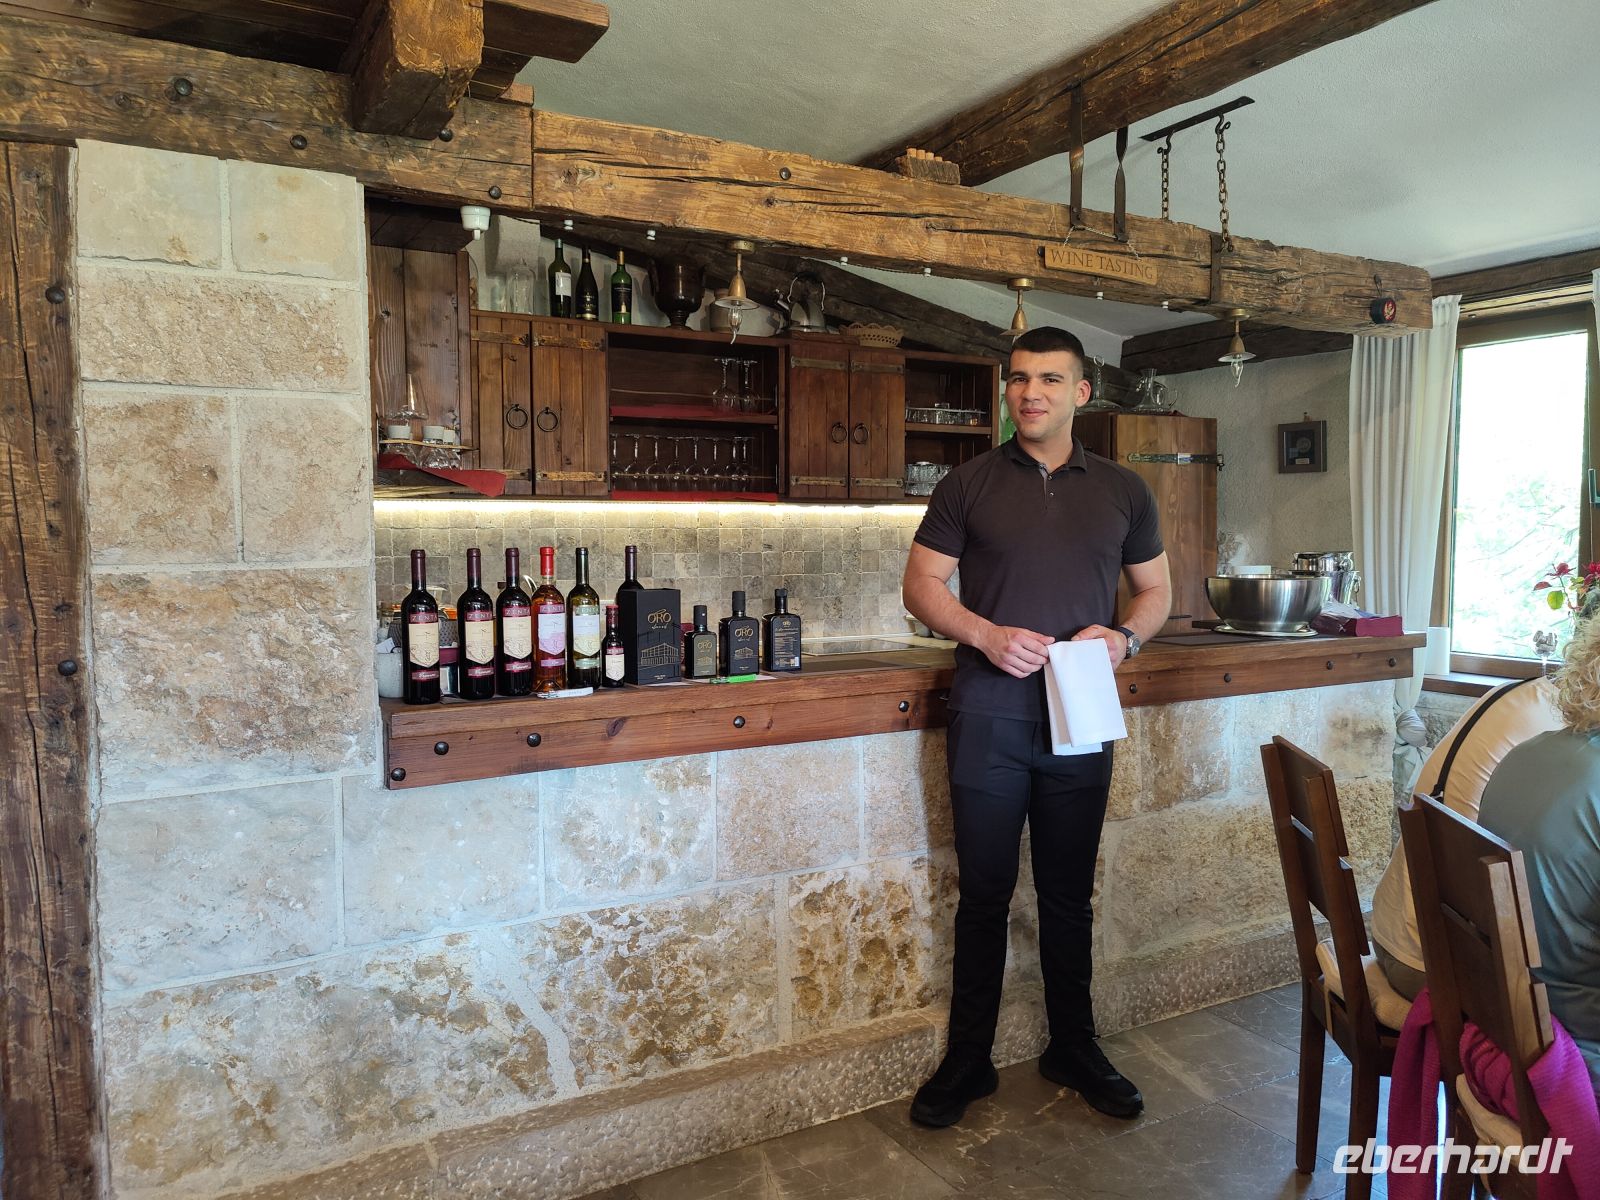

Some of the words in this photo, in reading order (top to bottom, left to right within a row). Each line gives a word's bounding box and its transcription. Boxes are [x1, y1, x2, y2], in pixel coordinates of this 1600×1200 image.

[1050, 249, 1093, 267] WINE
[1096, 255, 1153, 280] TASTING
[648, 609, 672, 624] ORO
[735, 626, 754, 637] ORO
[697, 641, 713, 649] ORO
